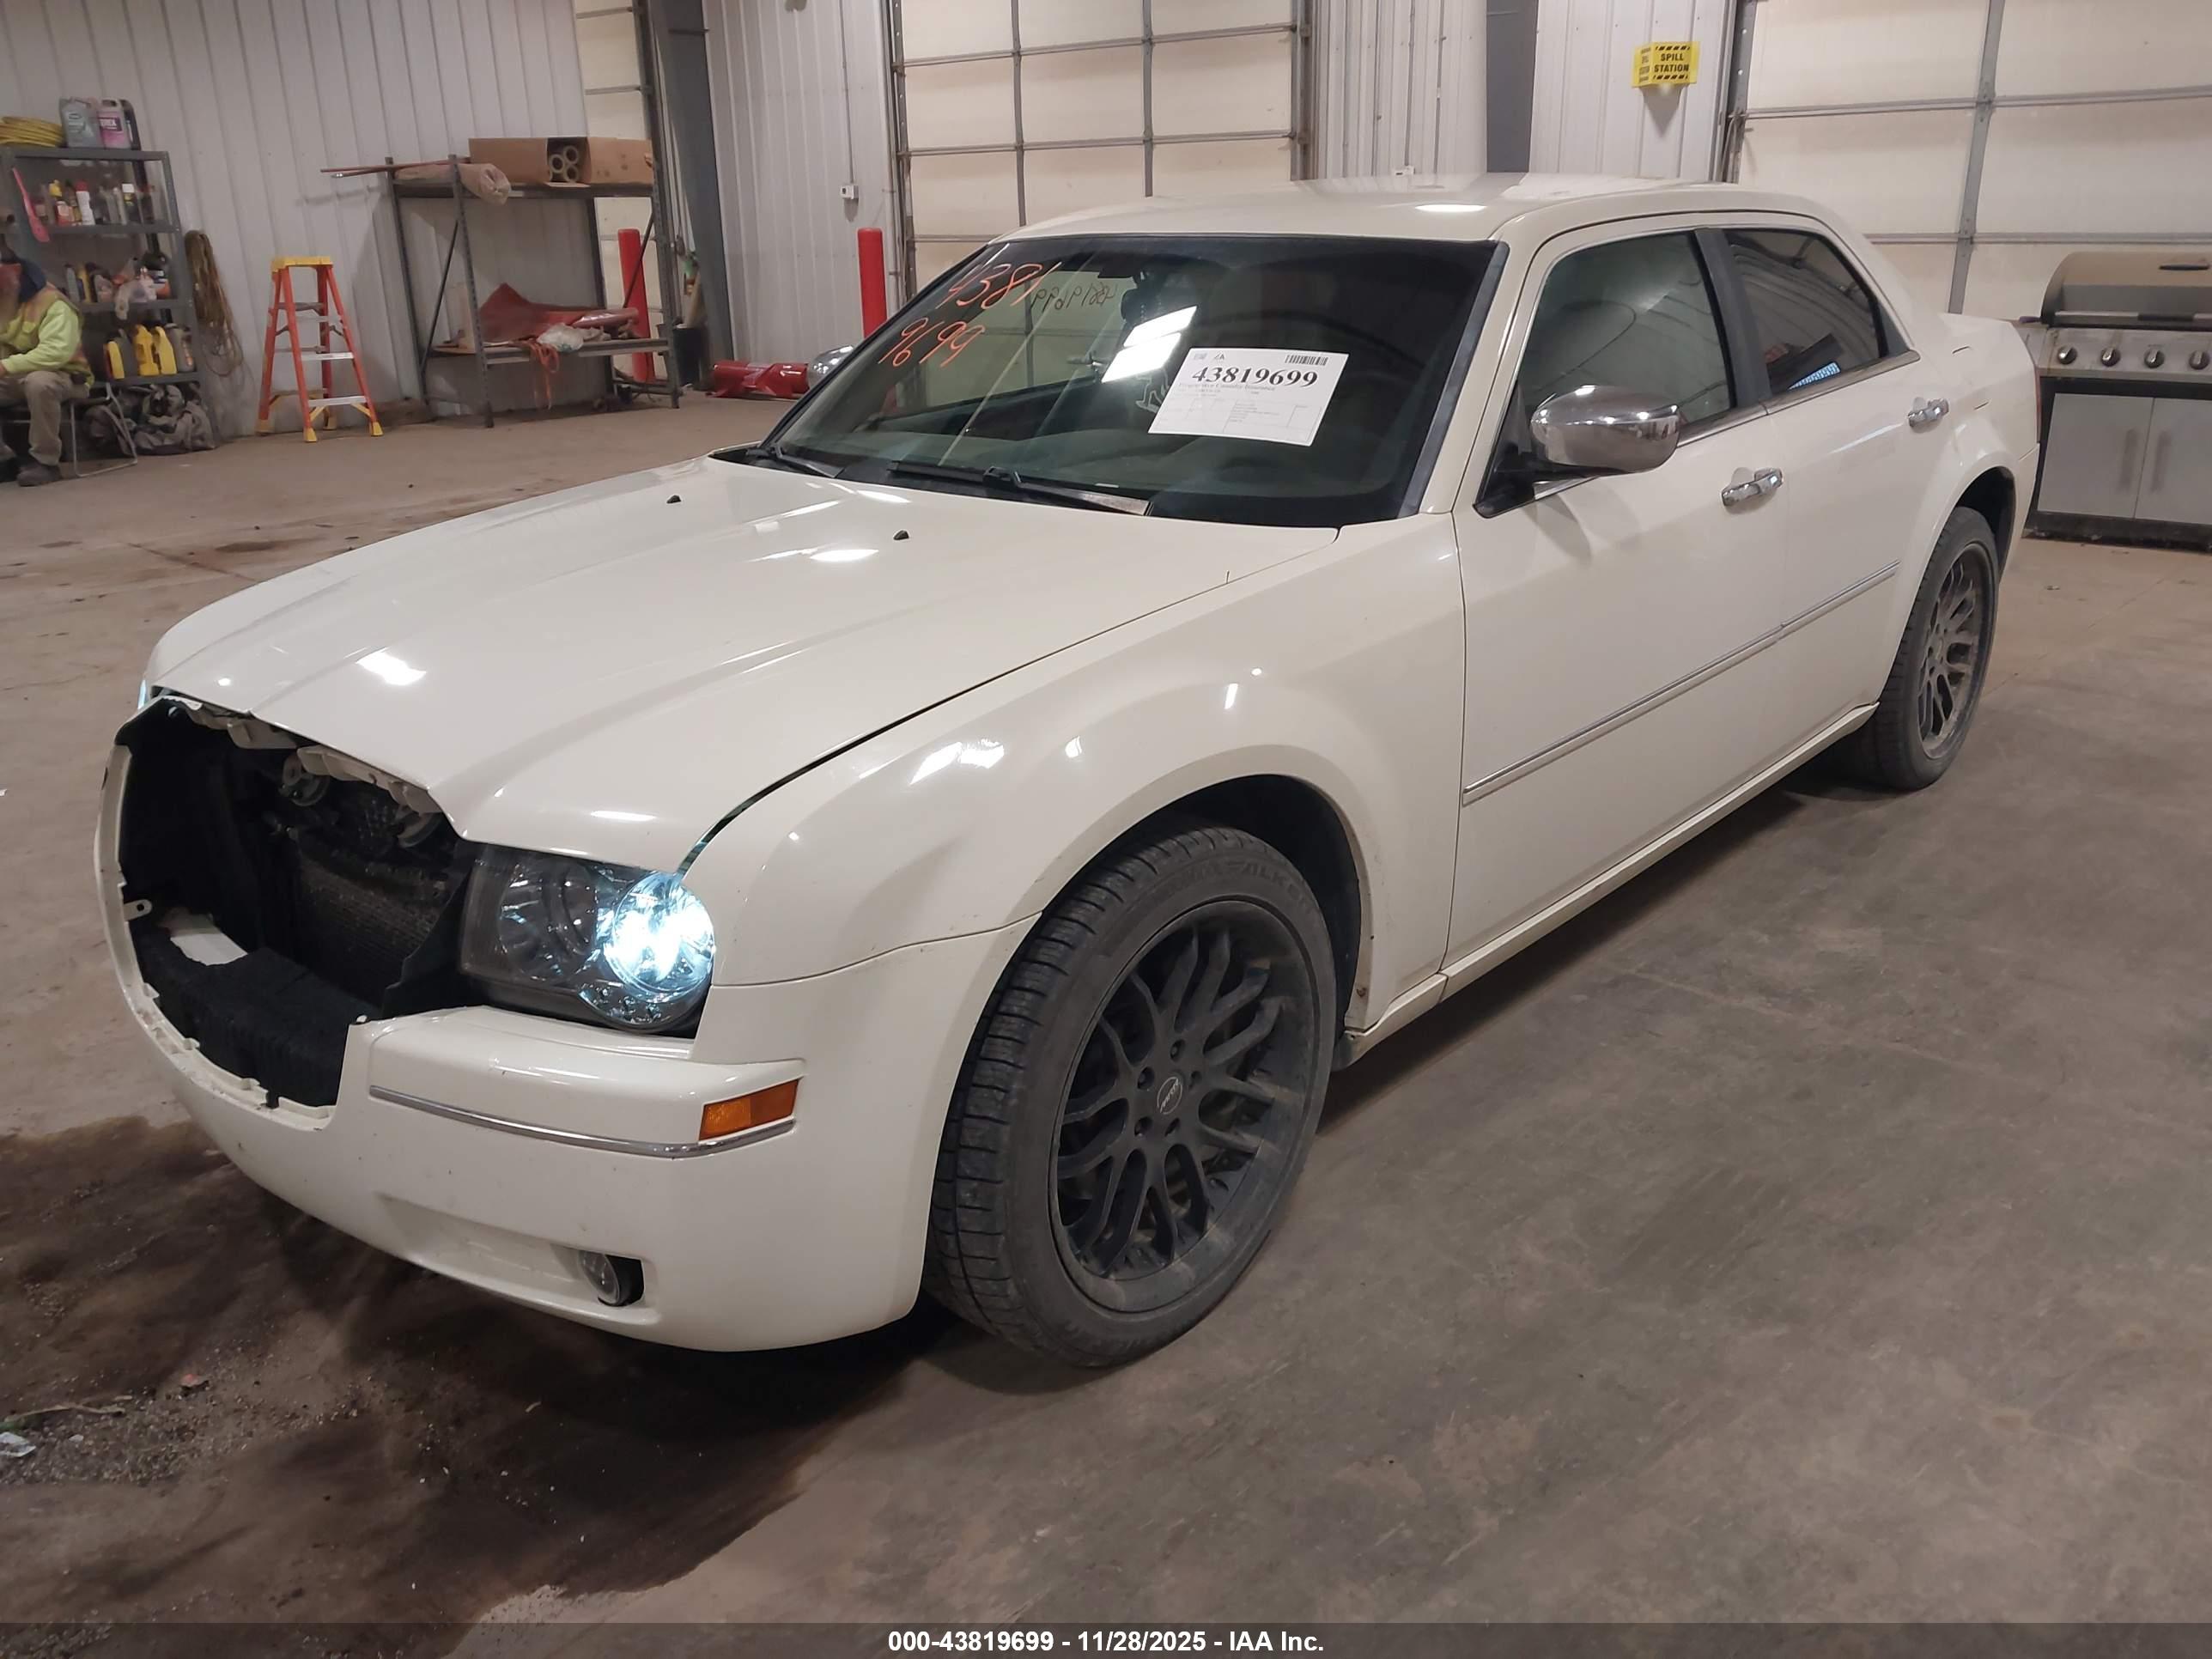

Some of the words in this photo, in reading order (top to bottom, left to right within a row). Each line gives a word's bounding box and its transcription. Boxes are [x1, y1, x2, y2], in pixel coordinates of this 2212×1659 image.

[1660, 52, 1684, 61] SPILL
[1654, 64, 1689, 73] STATION
[936, 262, 1062, 310] 4381
[878, 317, 987, 368] 9699
[1192, 367, 1318, 387] 43819699
